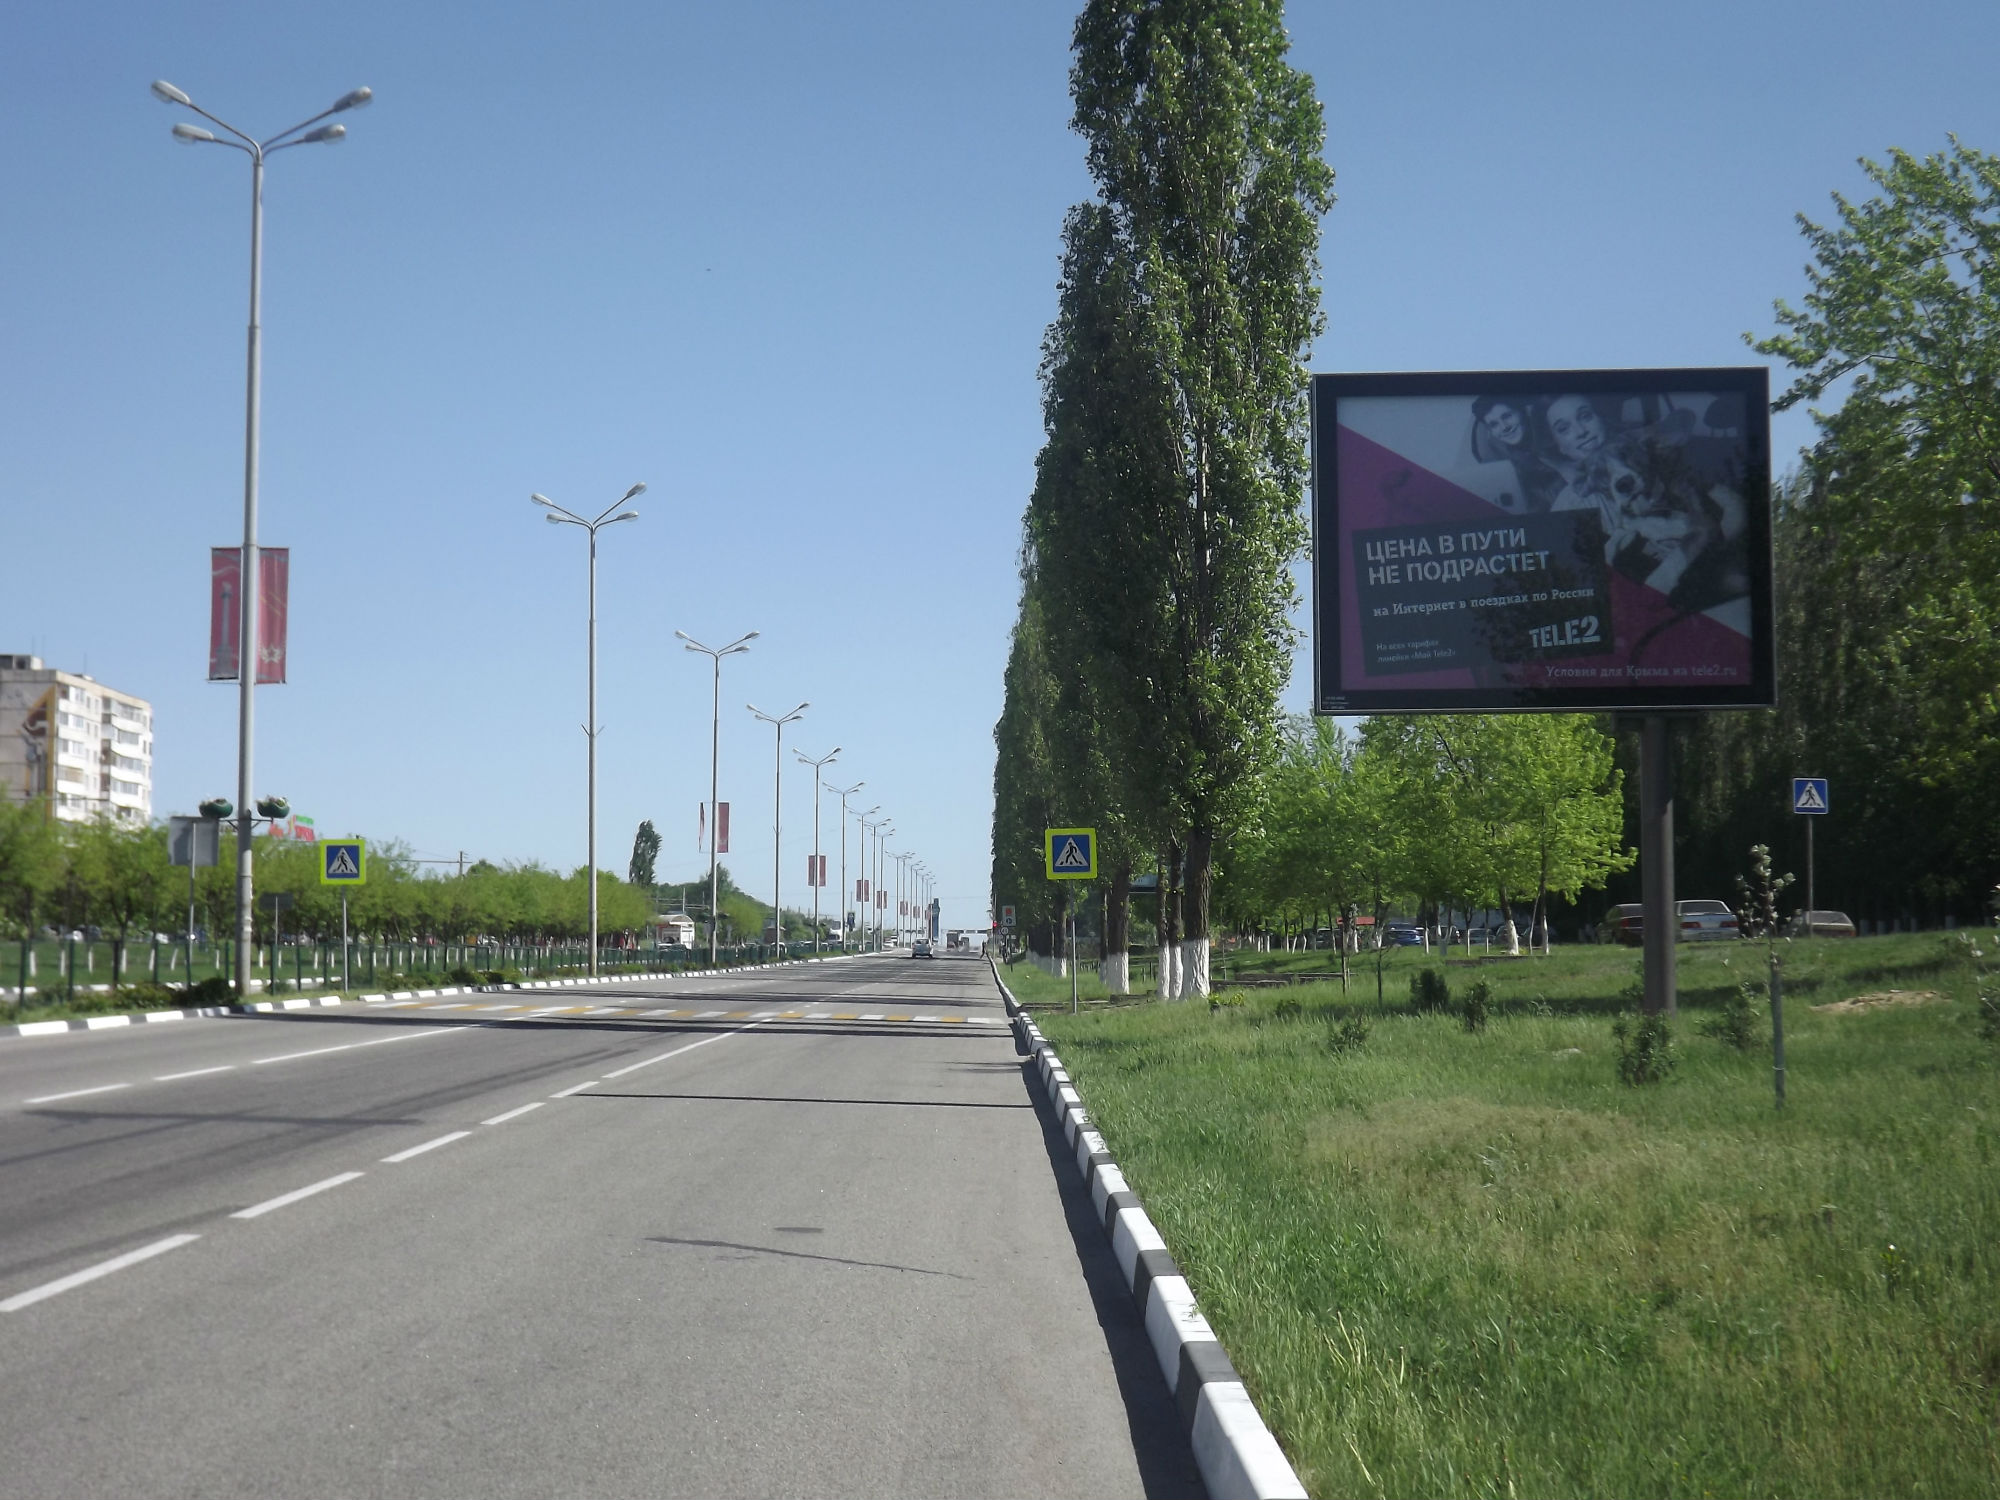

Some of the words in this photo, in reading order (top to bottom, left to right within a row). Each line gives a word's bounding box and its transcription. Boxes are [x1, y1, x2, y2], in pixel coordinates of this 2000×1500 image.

[1366, 537, 1432, 563] ЦЕНА
[1439, 535, 1454, 554] В
[1461, 528, 1526, 551] ПУТИ
[1368, 565, 1400, 586] НЕ
[1406, 550, 1549, 583] ПОДРАСТЕТ
[1373, 607, 1389, 616] на
[1393, 600, 1455, 616] Интернет
[1460, 600, 1466, 609] в
[1471, 594, 1528, 608] поездках
[1532, 591, 1548, 602] по
[1552, 588, 1595, 600] России
[1529, 615, 1601, 648] TELE2
[1545, 666, 1596, 678] Условия
[1600, 666, 1623, 678] для
[1626, 665, 1669, 679] Крыма
[1673, 667, 1687, 676] на
[1692, 664, 1737, 676] tele2.ru
